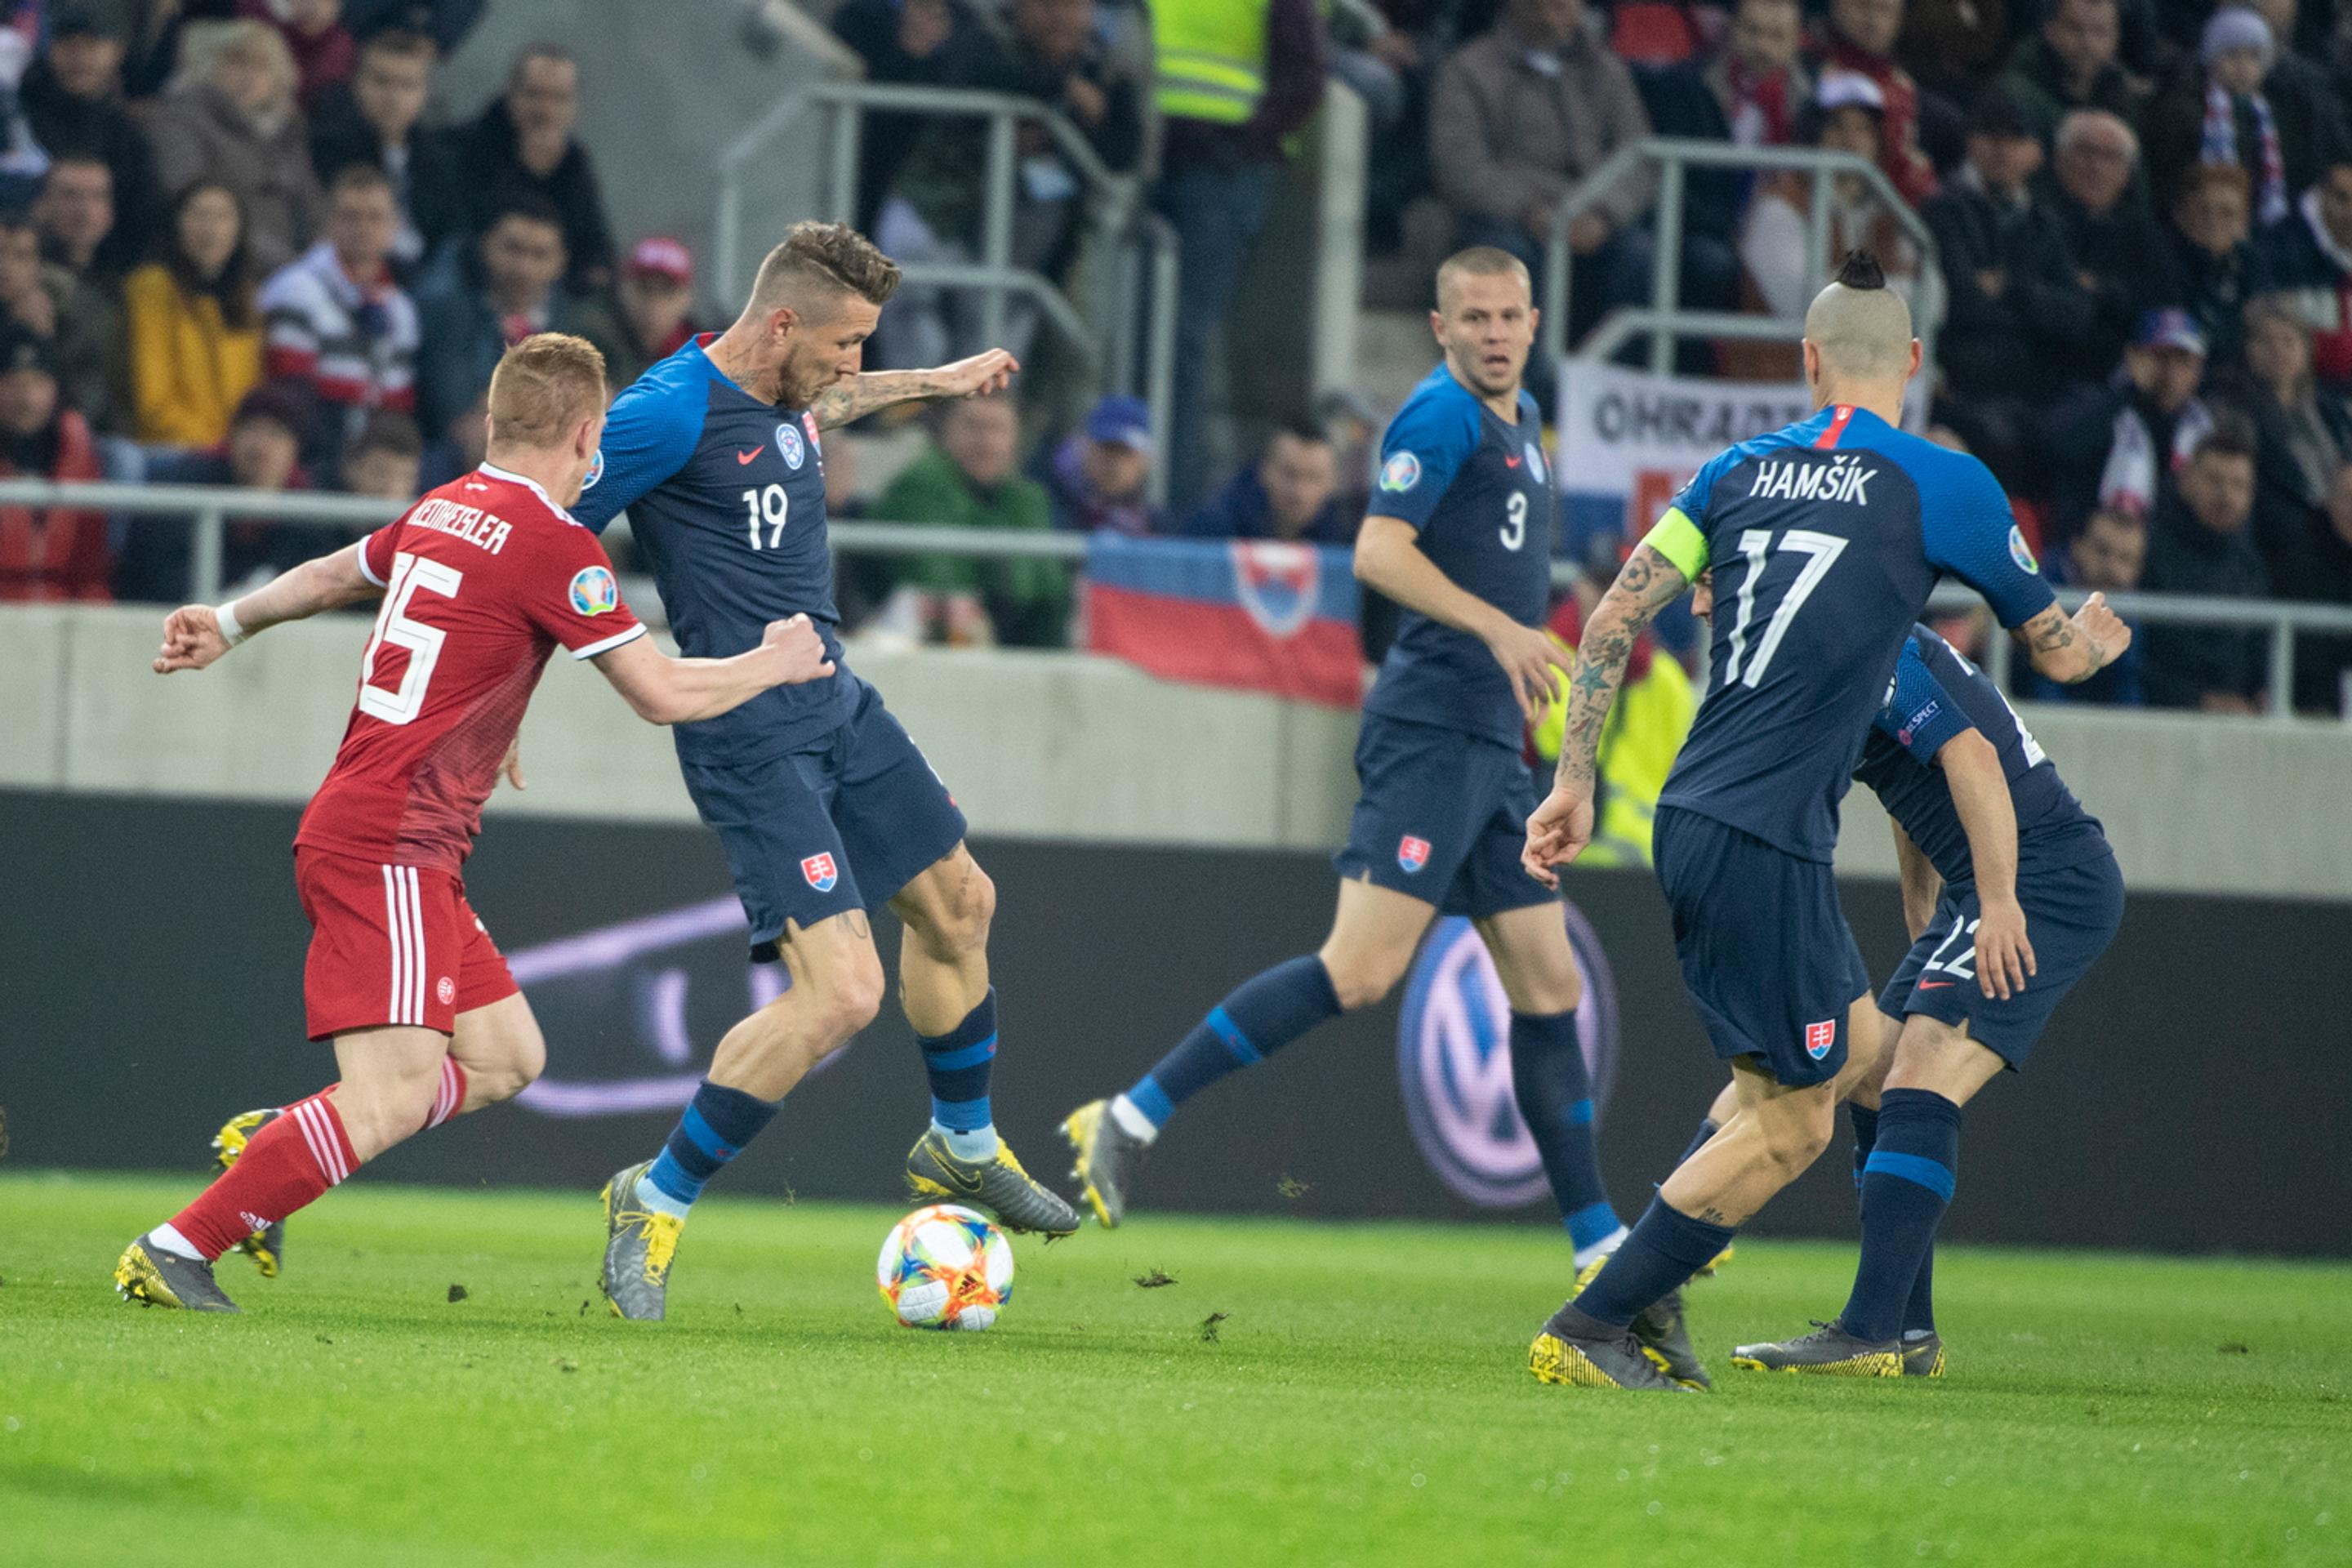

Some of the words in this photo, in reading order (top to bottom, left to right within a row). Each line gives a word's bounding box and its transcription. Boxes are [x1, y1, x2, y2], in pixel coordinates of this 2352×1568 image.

[1748, 455, 1878, 506] HAMŠÍK
[742, 483, 789, 550] 19
[1499, 491, 1528, 552] 3
[358, 550, 464, 726] 15
[1724, 529, 1850, 689] 17
[1922, 914, 1981, 980] 22
